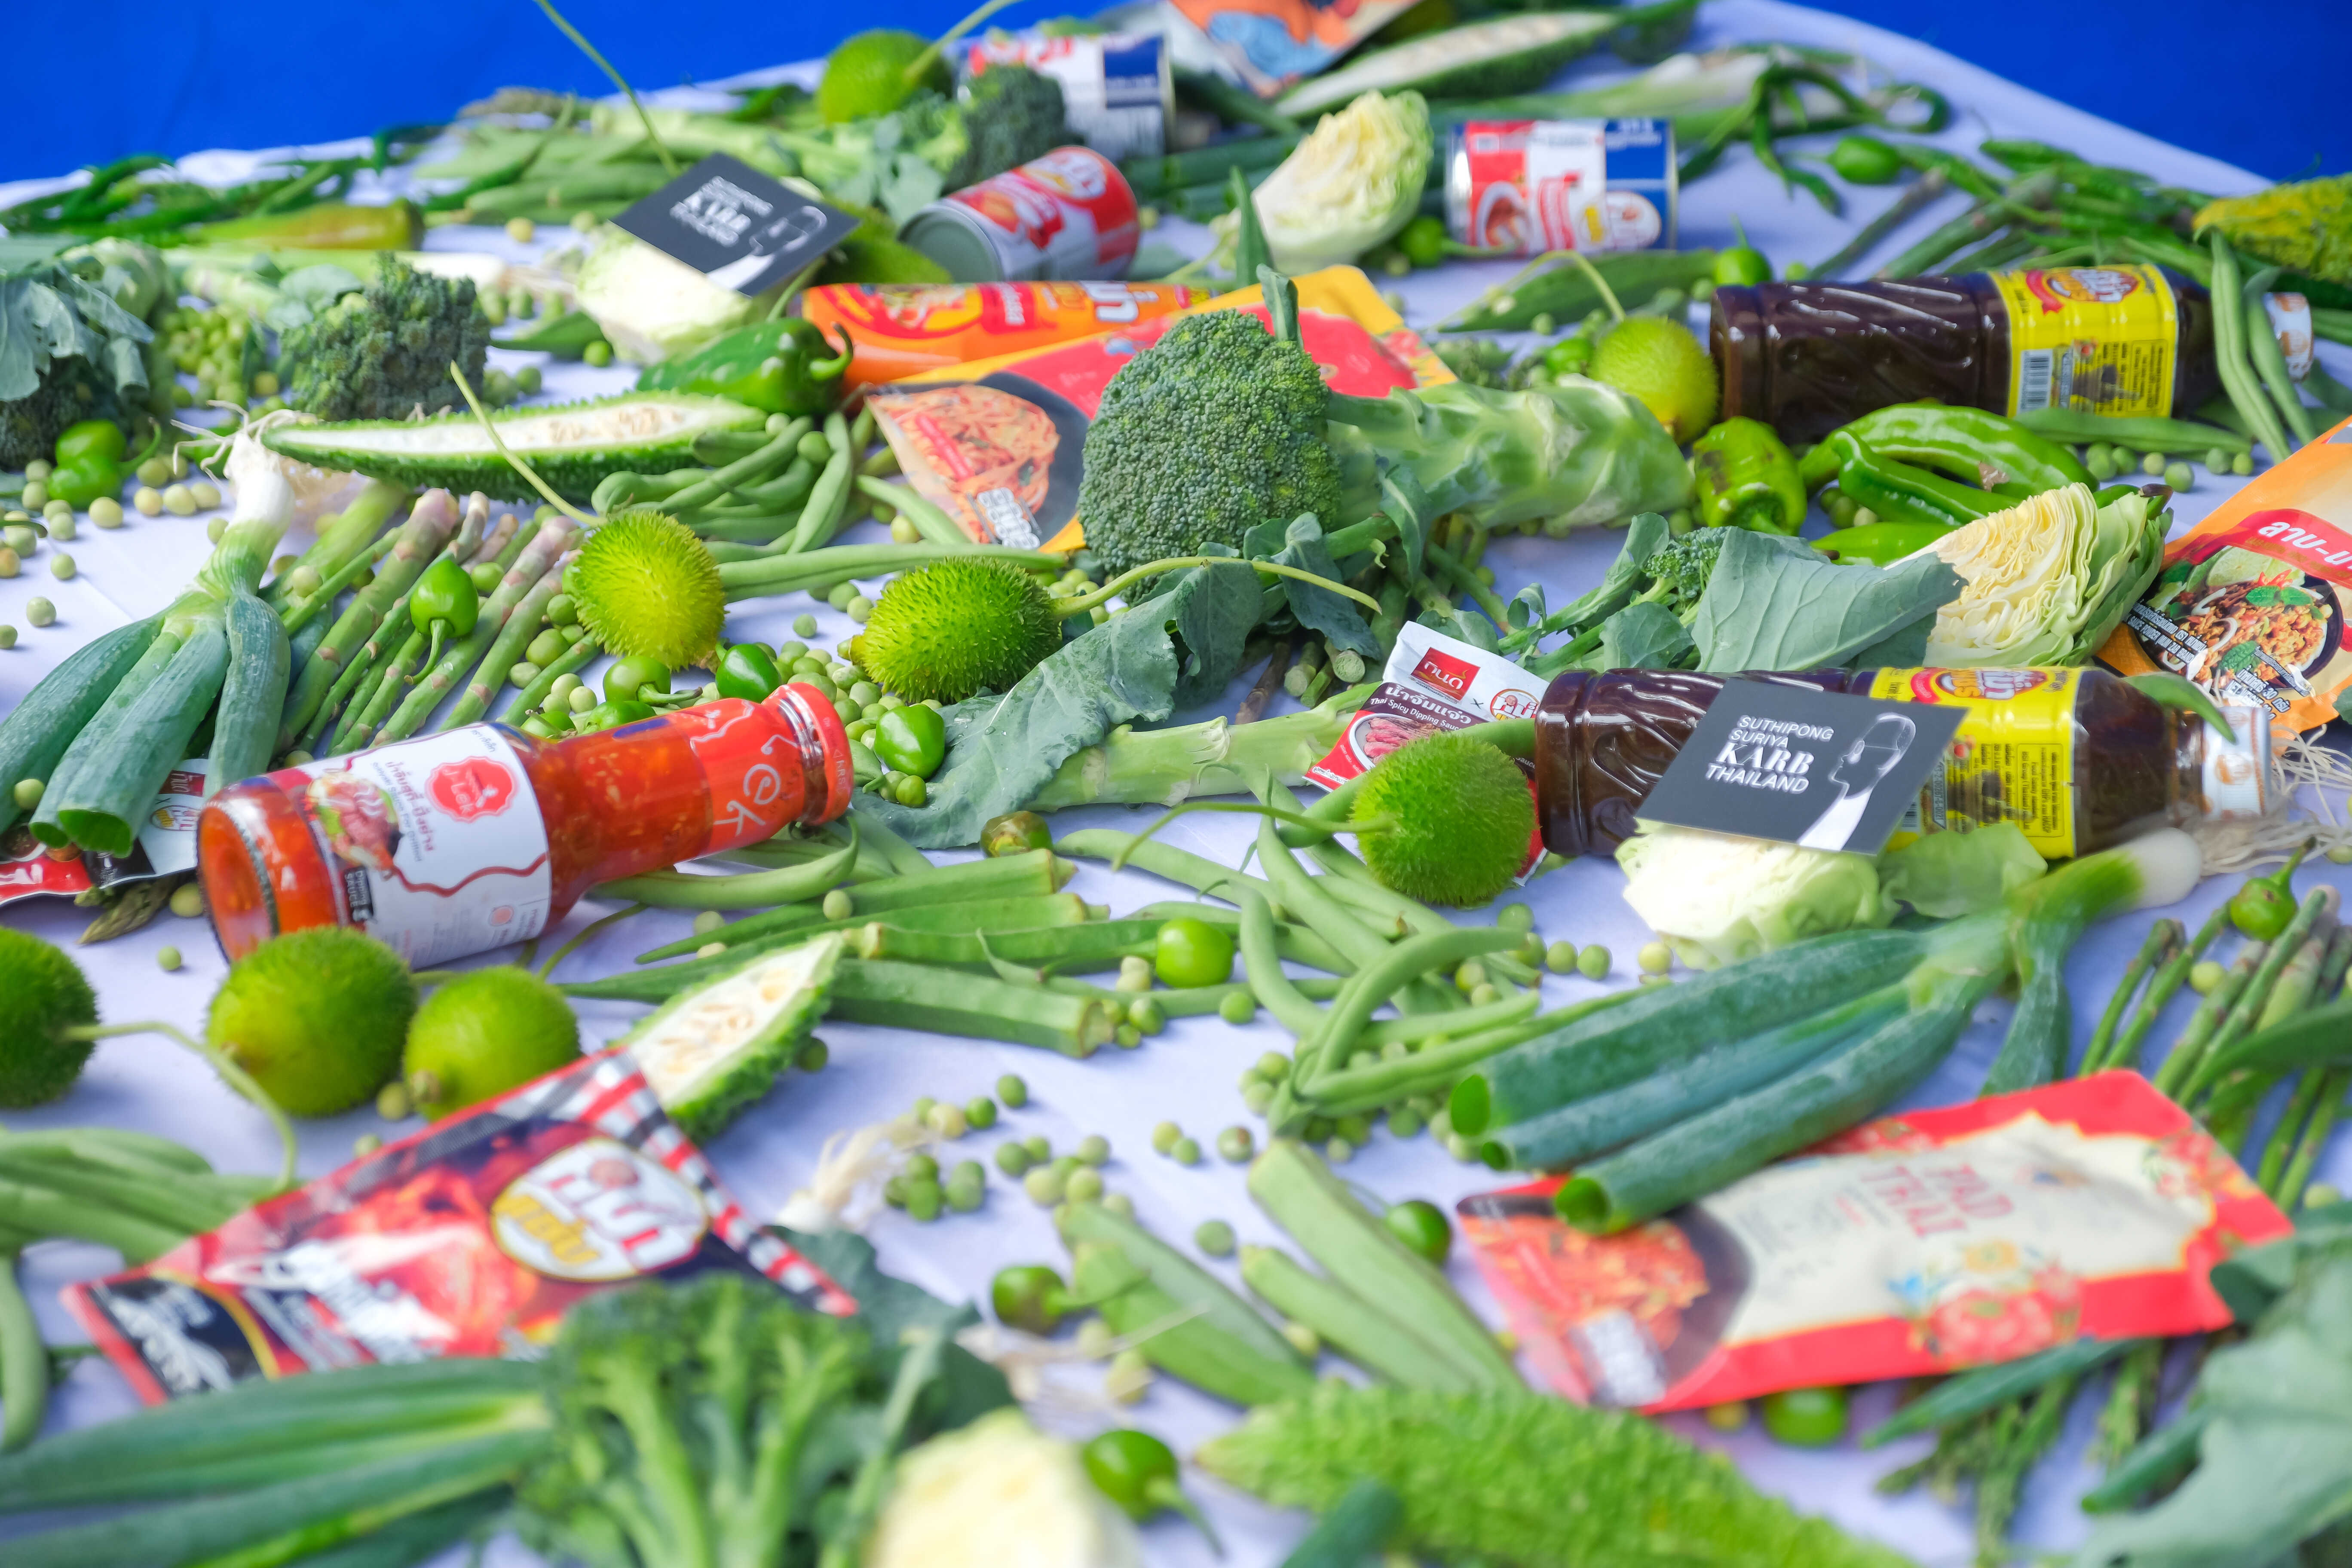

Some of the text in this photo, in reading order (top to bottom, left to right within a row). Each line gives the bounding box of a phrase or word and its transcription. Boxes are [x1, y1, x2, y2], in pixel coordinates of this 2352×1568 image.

[1385, 684, 1472, 724] น้ำจิ้มแจ่ว
[1388, 699, 1409, 714] Spicy
[1410, 708, 1439, 725] Dipping
[1730, 729, 1789, 749] SURIYA
[1738, 716, 1834, 741] SUTHIPONG
[1716, 742, 1815, 775] KARB
[1706, 764, 1810, 793] THAILAND
